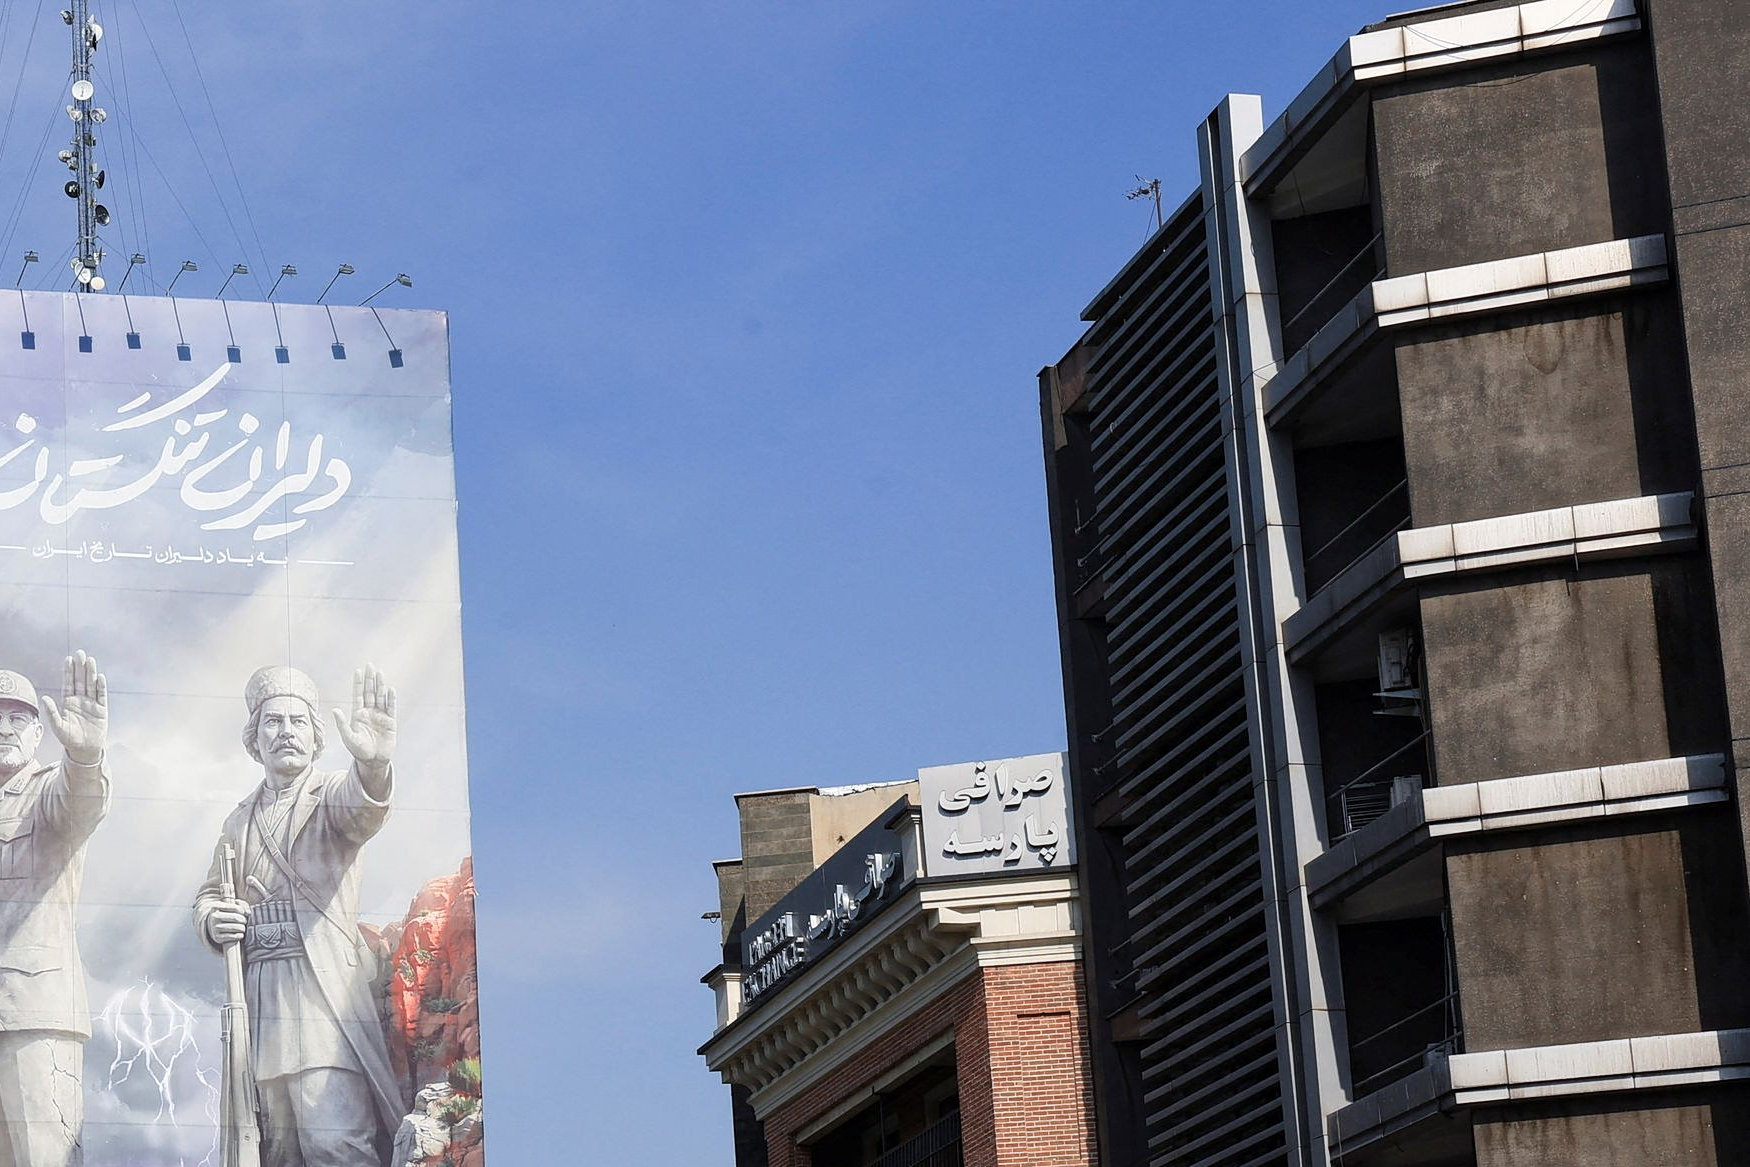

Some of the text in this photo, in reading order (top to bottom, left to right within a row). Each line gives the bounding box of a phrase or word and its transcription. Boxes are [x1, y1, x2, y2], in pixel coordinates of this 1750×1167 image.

[181, 413, 351, 541] دلیران
[32, 539, 289, 567] به یاد دلیران تاریخ ایران
[937, 760, 1054, 812] صرافی
[942, 814, 1060, 864] پارسه
